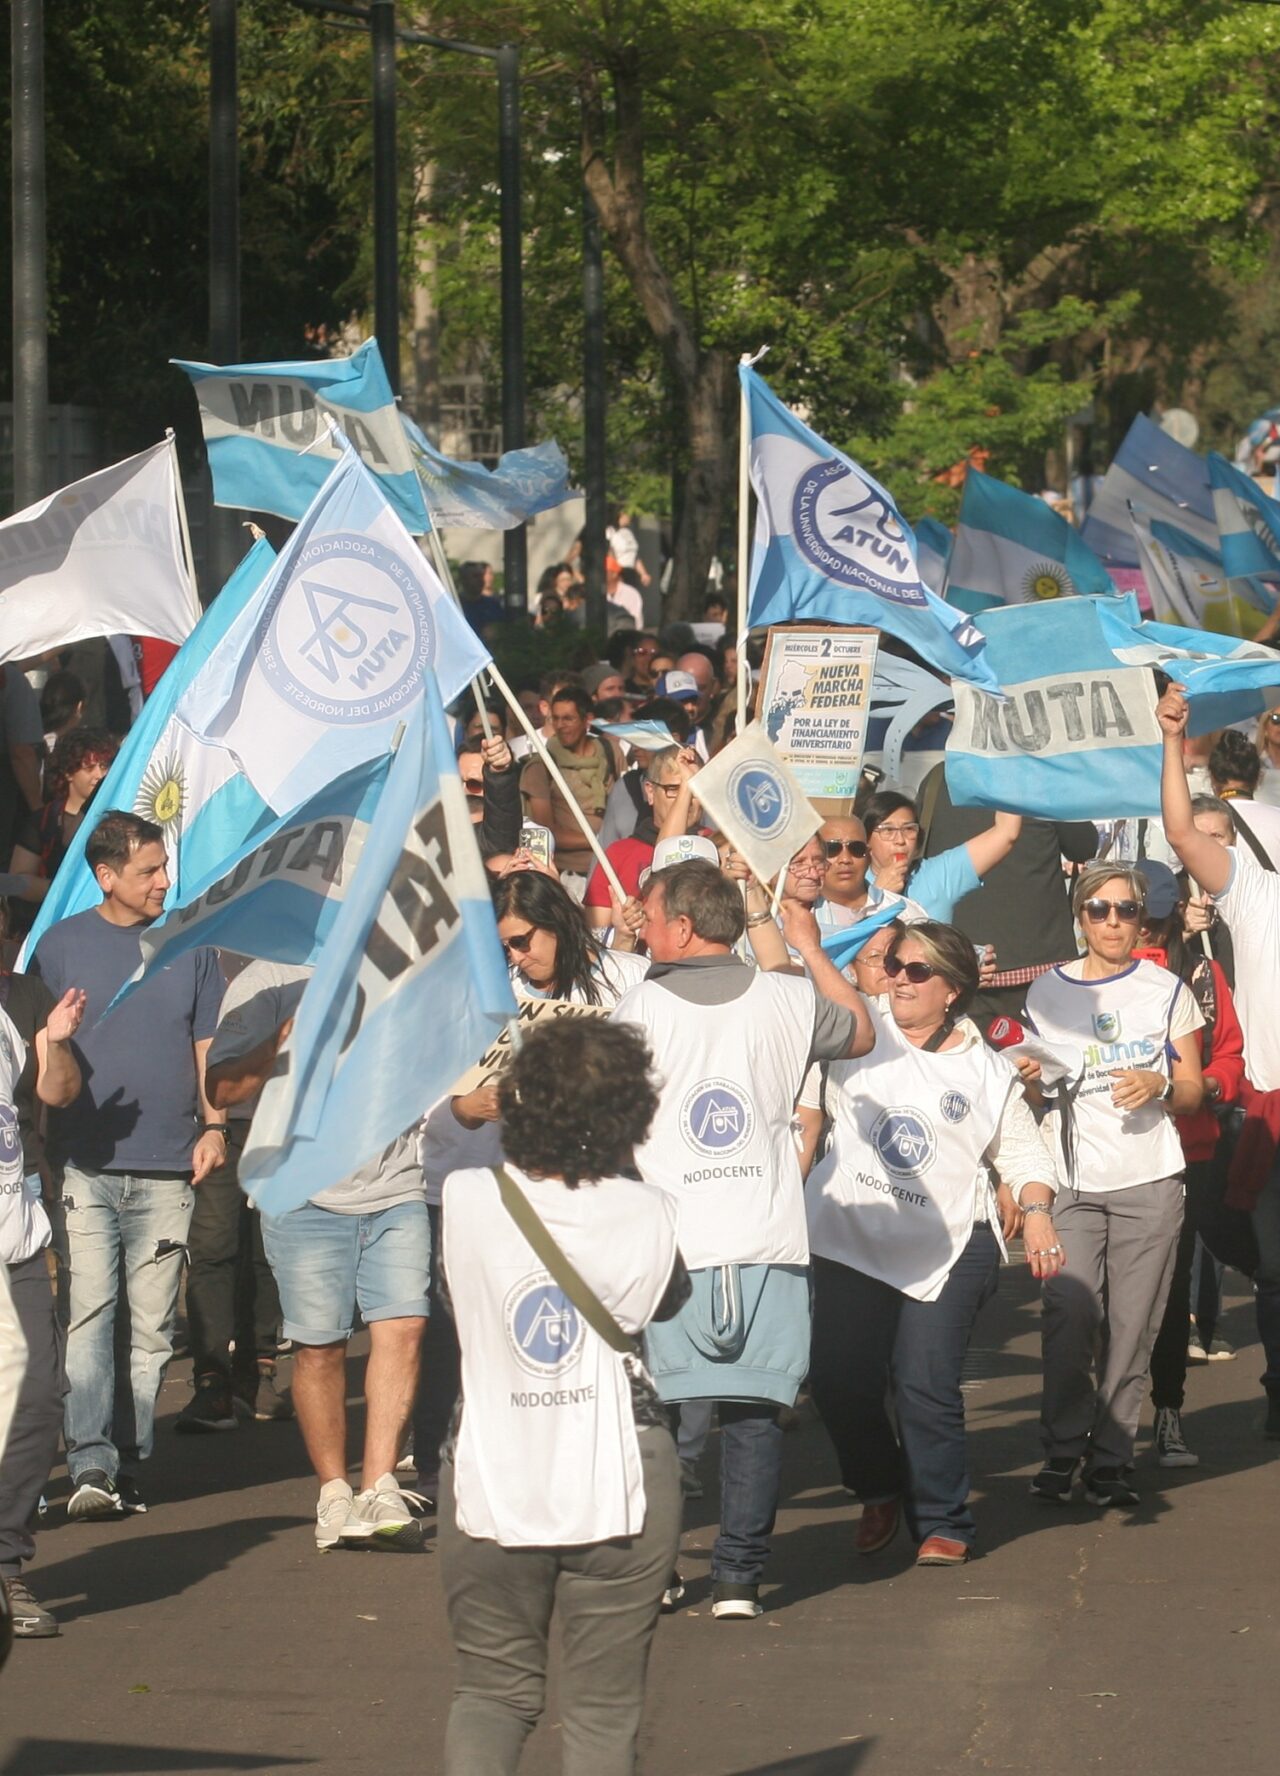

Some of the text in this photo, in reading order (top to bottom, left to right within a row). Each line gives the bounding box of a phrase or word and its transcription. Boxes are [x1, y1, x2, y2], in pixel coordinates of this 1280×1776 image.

[800, 480, 923, 600] DE LA UNIVERSIDAD NACIONAL DEL
[832, 525, 909, 574] ATUN
[821, 638, 832, 657] 2
[834, 645, 861, 654] OCTUBRE
[820, 664, 860, 680] NUEVA
[813, 679, 863, 694] MARCHA
[810, 694, 861, 708] FEDERAL
[794, 718, 850, 728] POR LA LEY DE
[792, 729, 859, 739] FINANCIAMIENTO
[791, 740, 851, 749] UNIVERSITARIO
[683, 1165, 763, 1185] NODOCENTE
[856, 1172, 928, 1207] NODOCENTE
[511, 1384, 595, 1408] NODOCENTE
